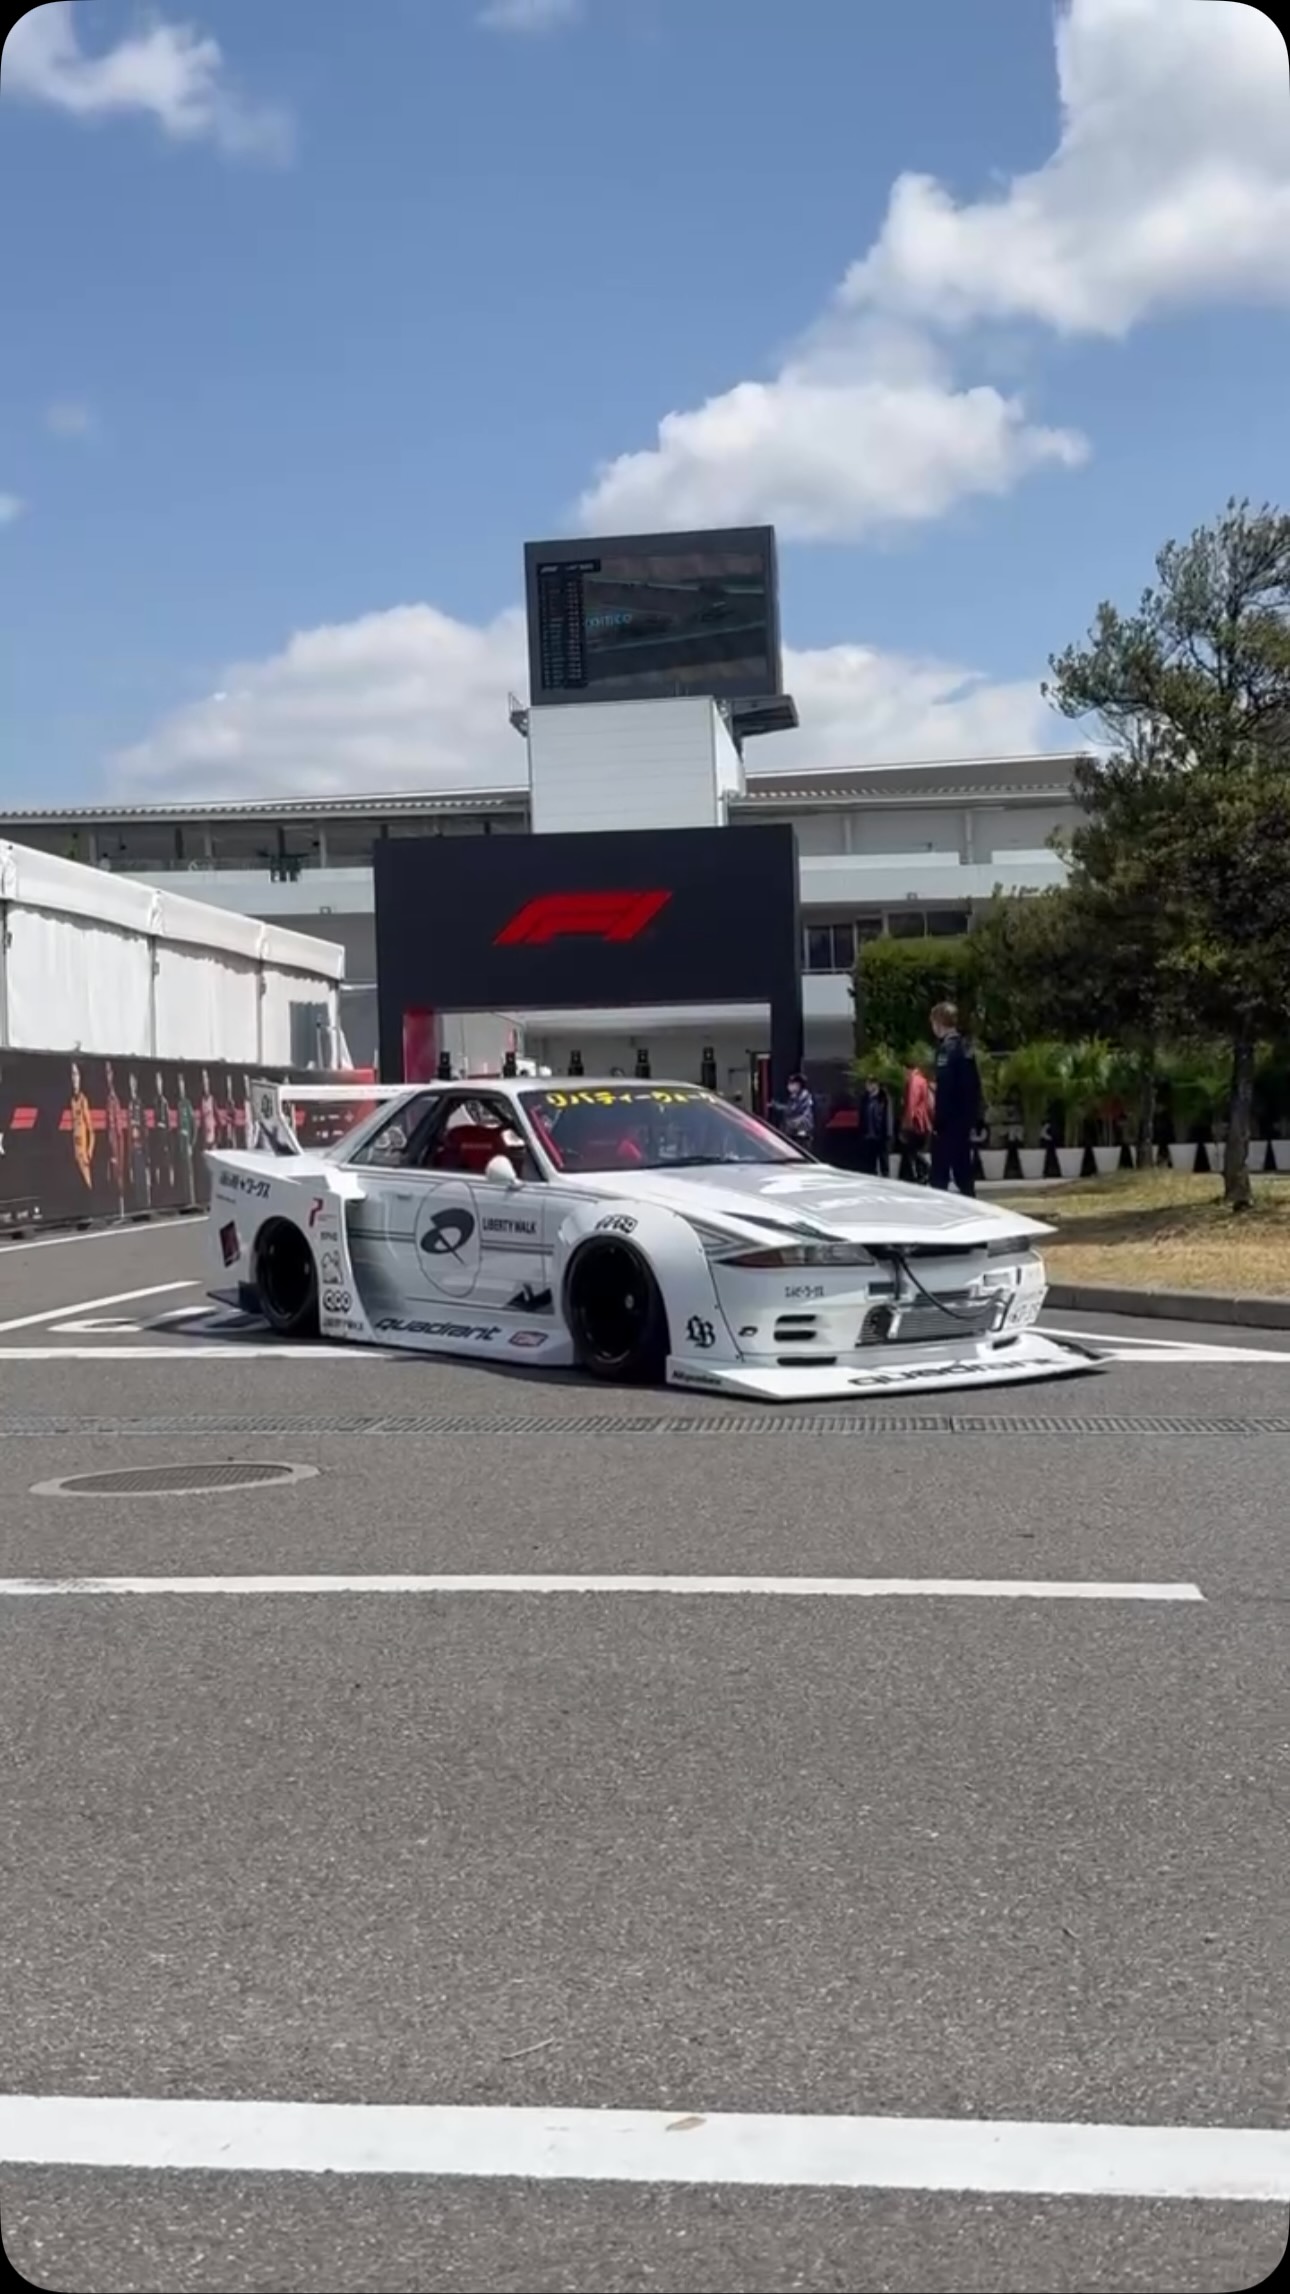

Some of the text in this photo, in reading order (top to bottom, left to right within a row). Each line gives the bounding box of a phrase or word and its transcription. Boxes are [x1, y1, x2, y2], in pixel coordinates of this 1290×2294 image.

[493, 889, 673, 945] F1
[482, 1216, 537, 1234] LIBERTY WALK
